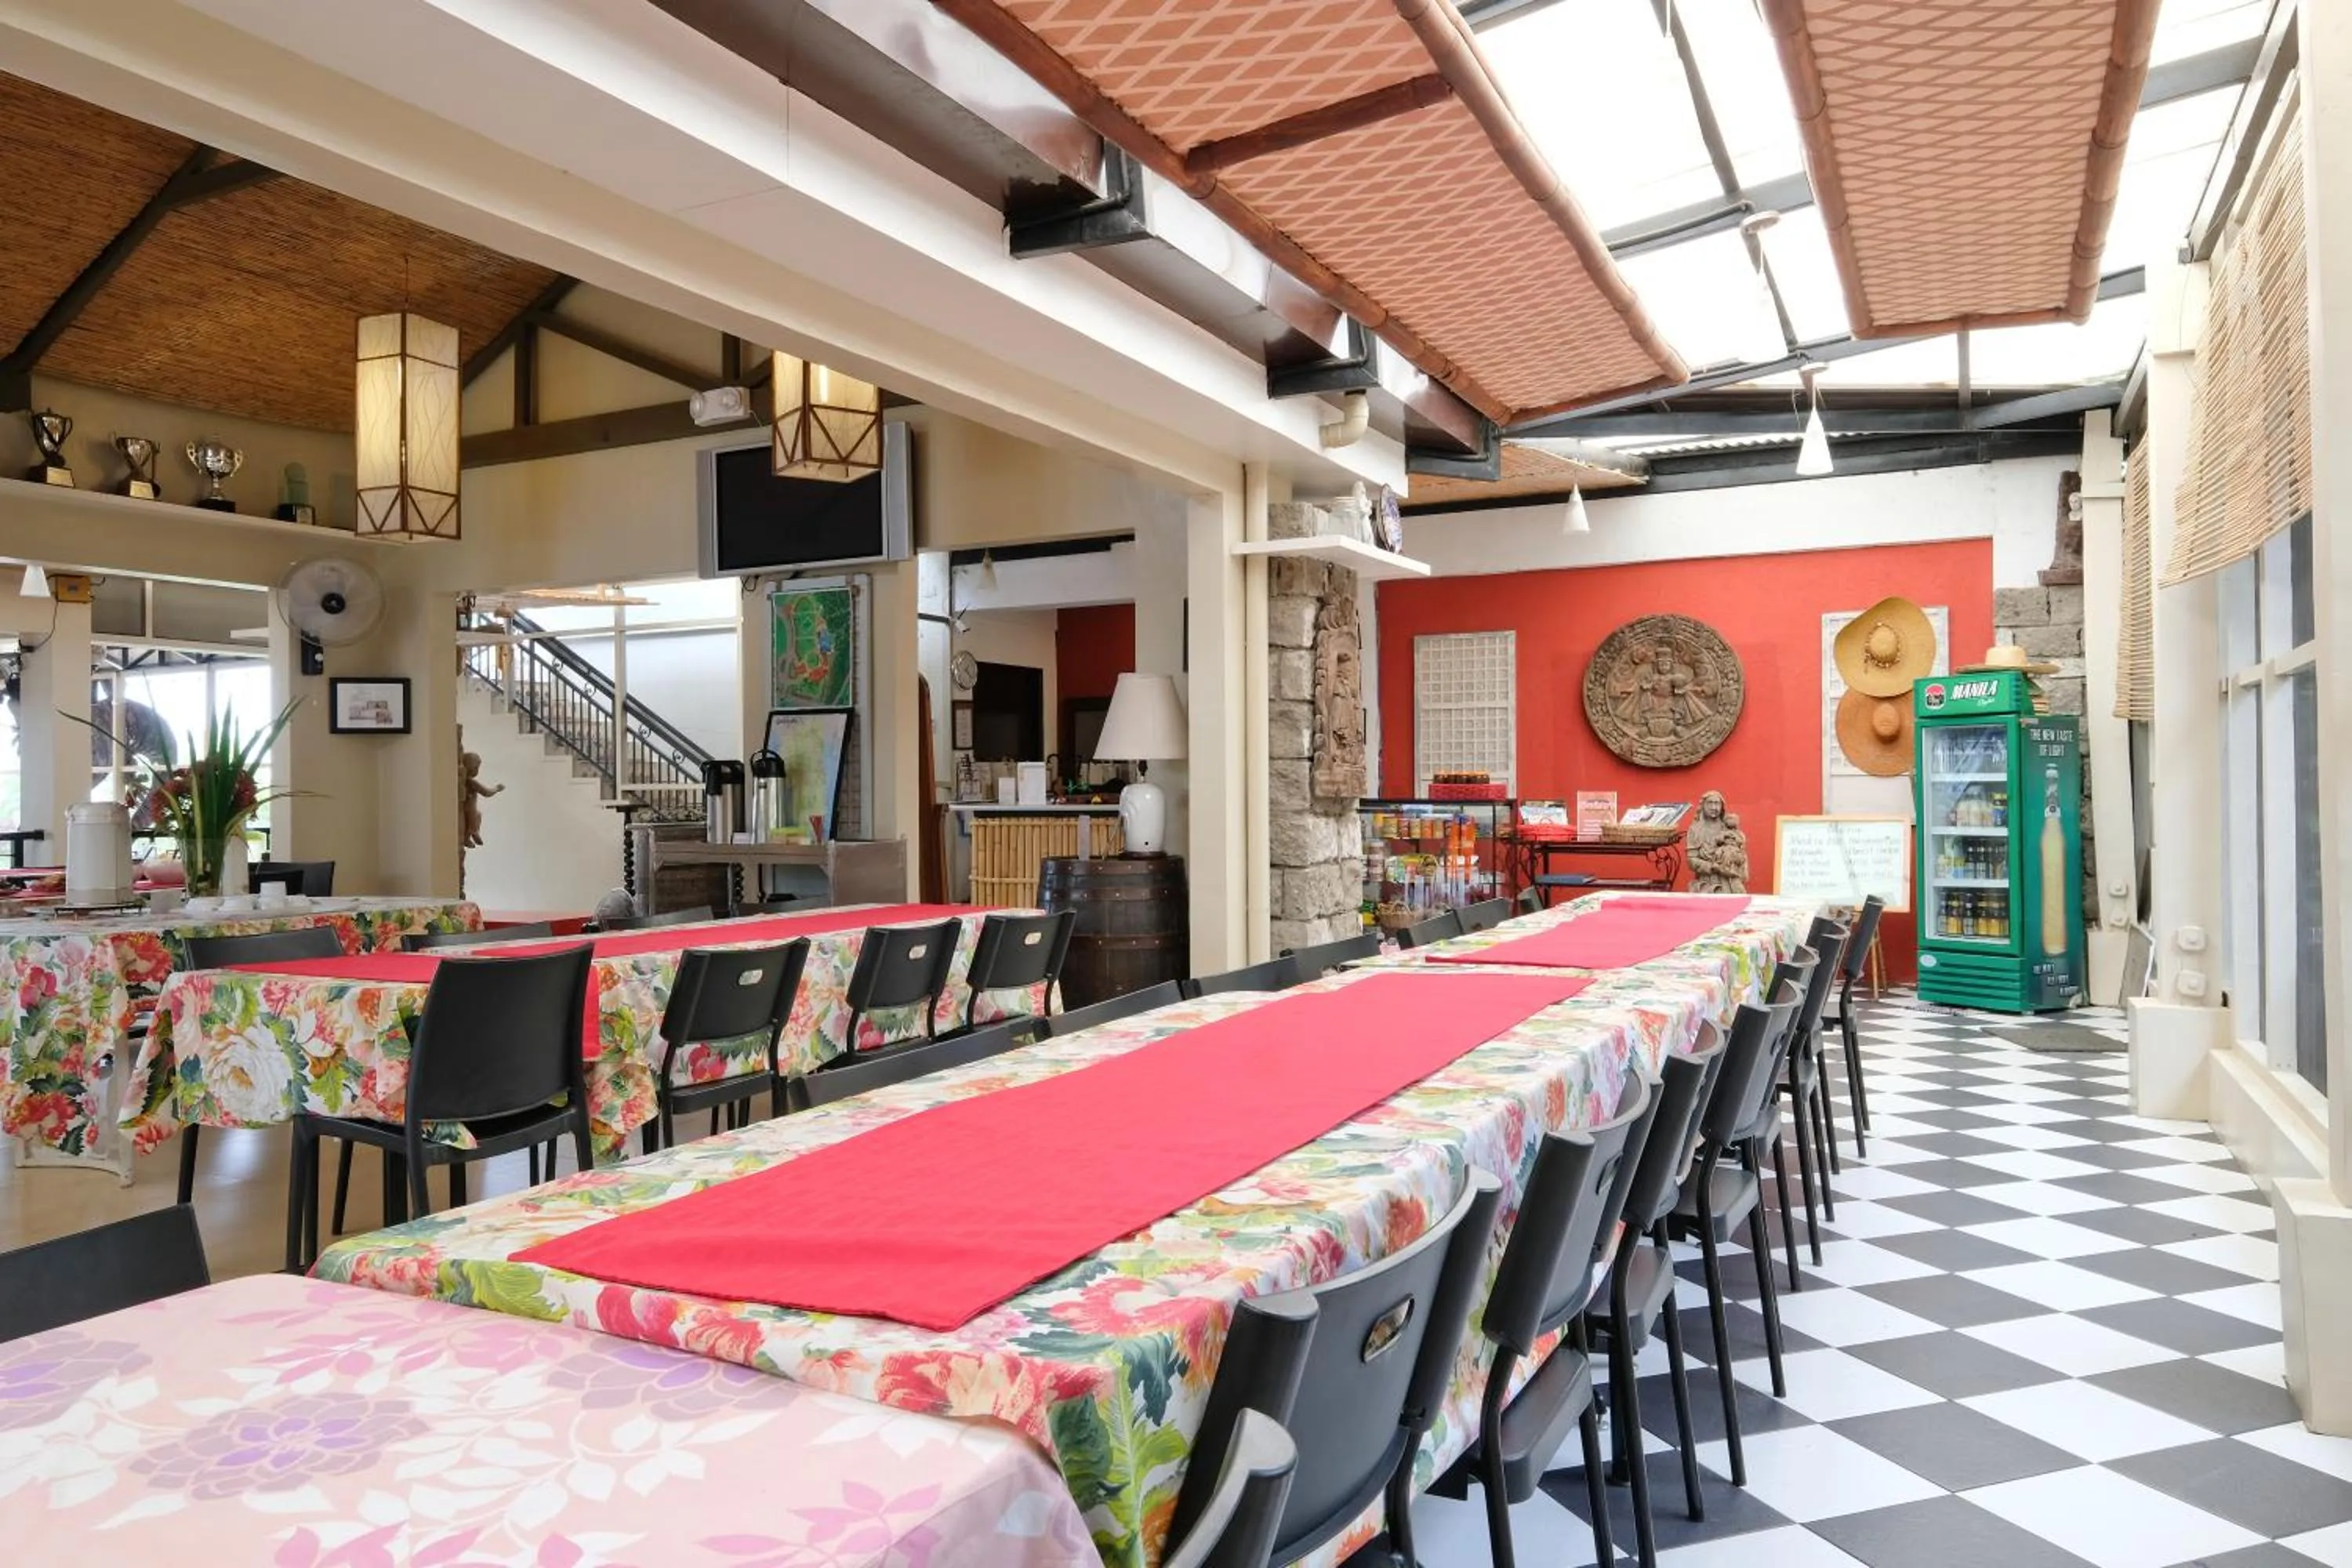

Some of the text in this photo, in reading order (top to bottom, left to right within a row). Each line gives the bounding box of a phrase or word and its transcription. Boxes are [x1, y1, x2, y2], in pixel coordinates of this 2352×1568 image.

[1951, 680, 1998, 699] MANILA
[2030, 728, 2074, 742] THE NEW TASTE
[2049, 744, 2064, 757] LIGHT
